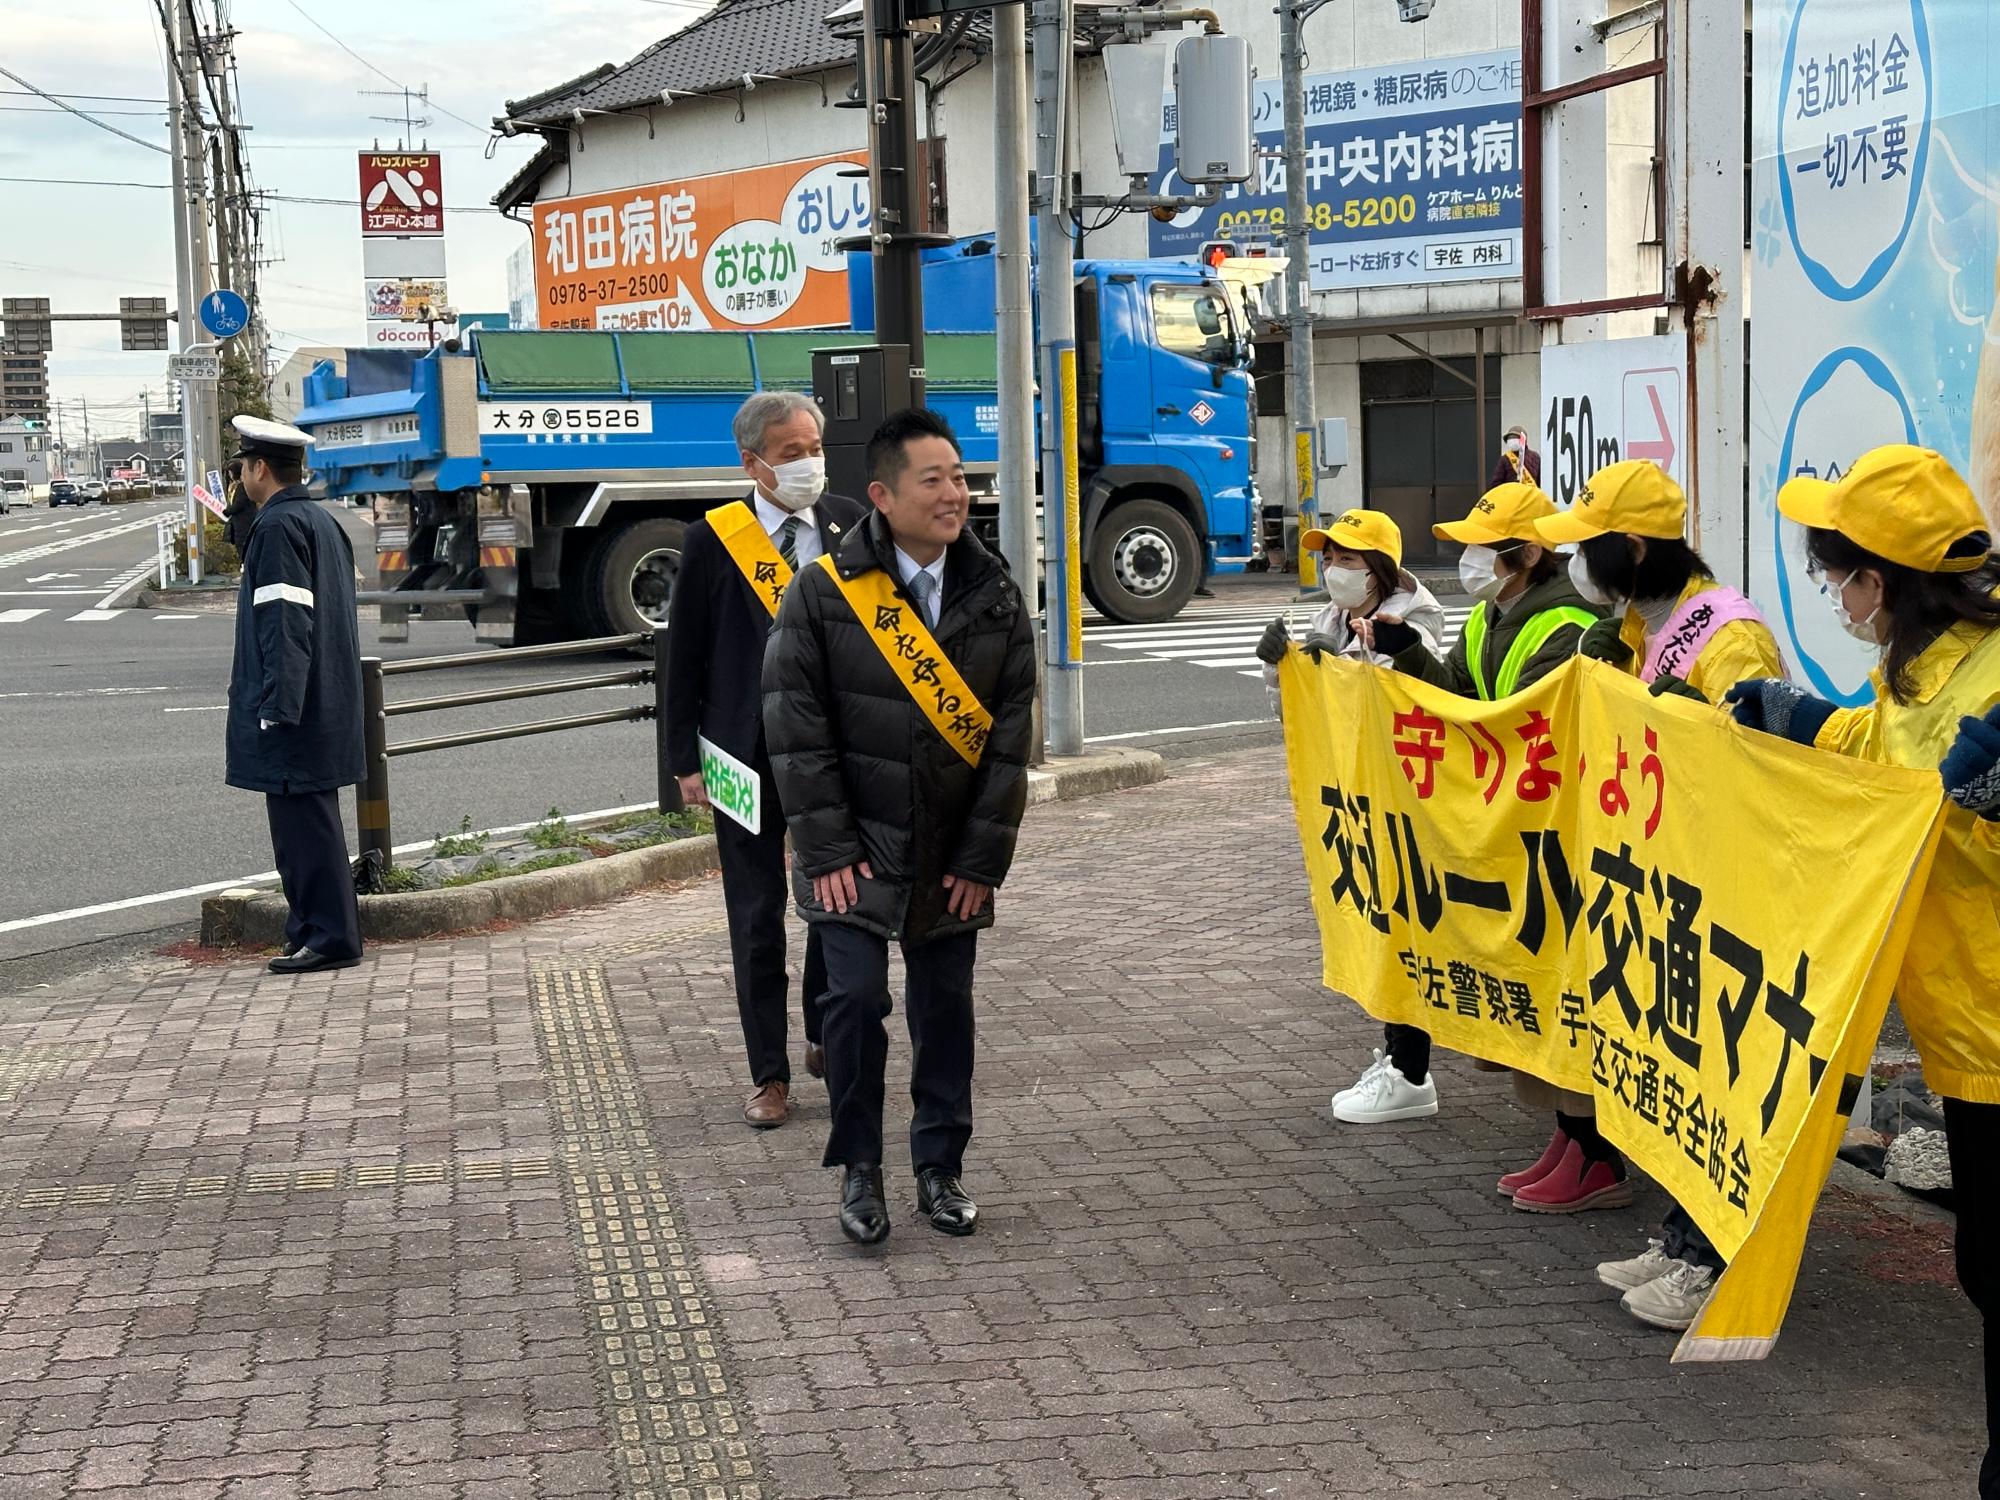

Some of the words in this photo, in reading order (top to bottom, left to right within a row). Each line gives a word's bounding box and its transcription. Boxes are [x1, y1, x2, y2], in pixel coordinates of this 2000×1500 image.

[1797, 32, 1910, 121] 追加料金
[1797, 114, 1908, 190] 一切不要
[797, 180, 872, 235] おしり
[1426, 202, 1500, 222] 病院直営隣接
[1427, 189, 1486, 206] ケアホーム
[545, 188, 698, 277] 和田病院
[714, 236, 797, 289] おなか
[1434, 247, 1464, 266] 宇佐
[1473, 243, 1502, 264] 内科
[549, 272, 669, 306] 0978-37-2500
[725, 289, 789, 312] の調子が悪い
[377, 327, 441, 342] docomo
[174, 368, 215, 377] ここから
[1546, 395, 1619, 505] 150m
[1393, 704, 1665, 841] 守りまょう
